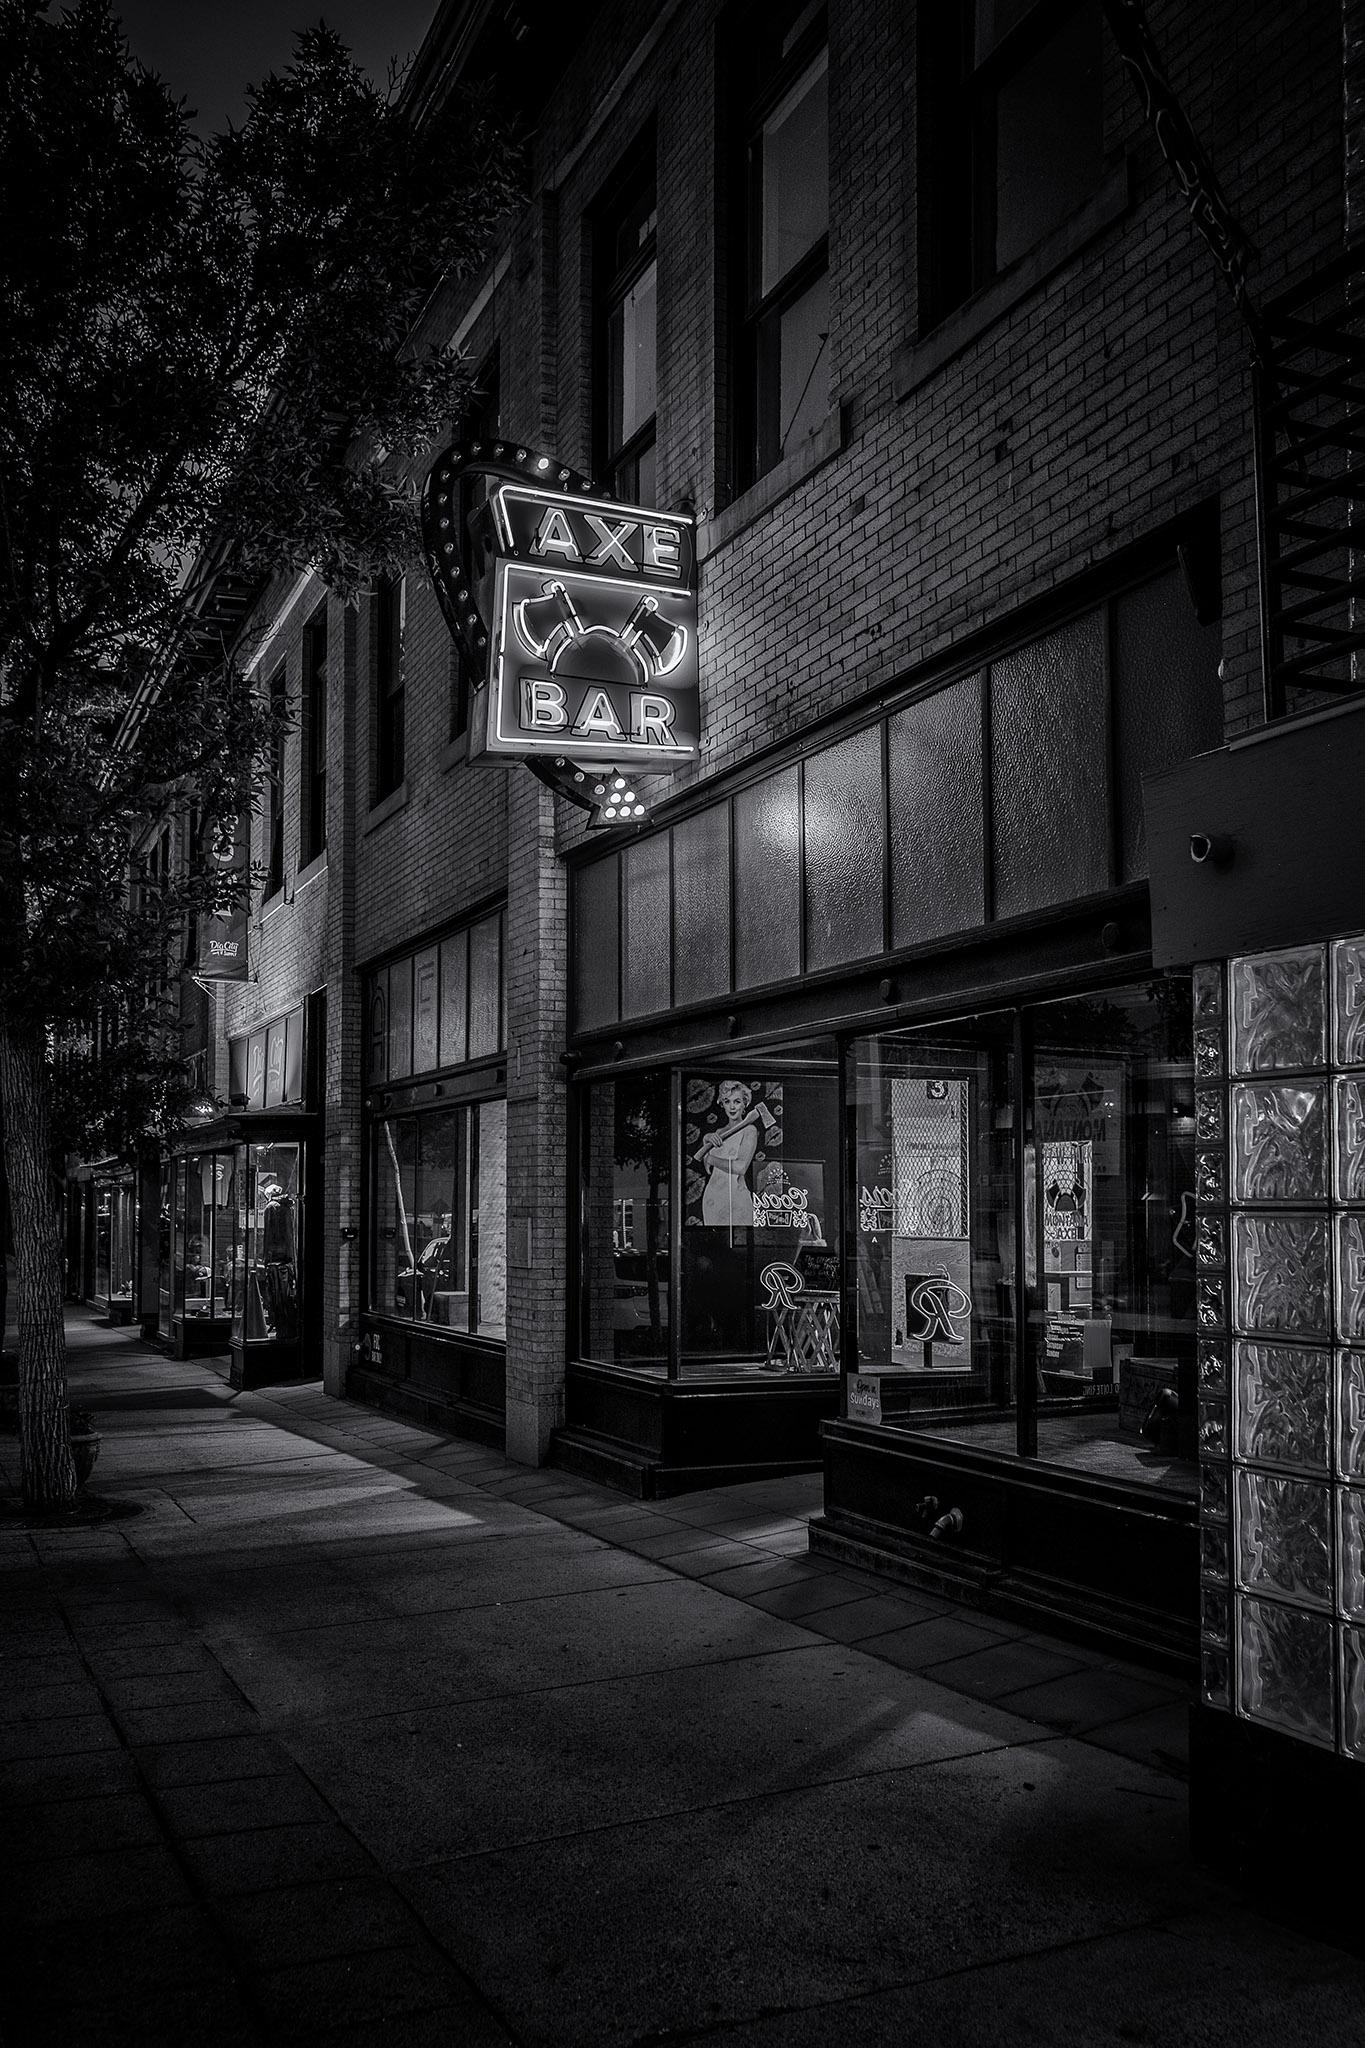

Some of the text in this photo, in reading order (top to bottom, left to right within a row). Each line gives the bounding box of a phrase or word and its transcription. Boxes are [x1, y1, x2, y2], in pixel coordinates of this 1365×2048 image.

[528, 506, 682, 580] AXE
[519, 676, 679, 746] BAR
[931, 1082, 945, 1098] 3
[850, 1392, 880, 1410] Sundays
